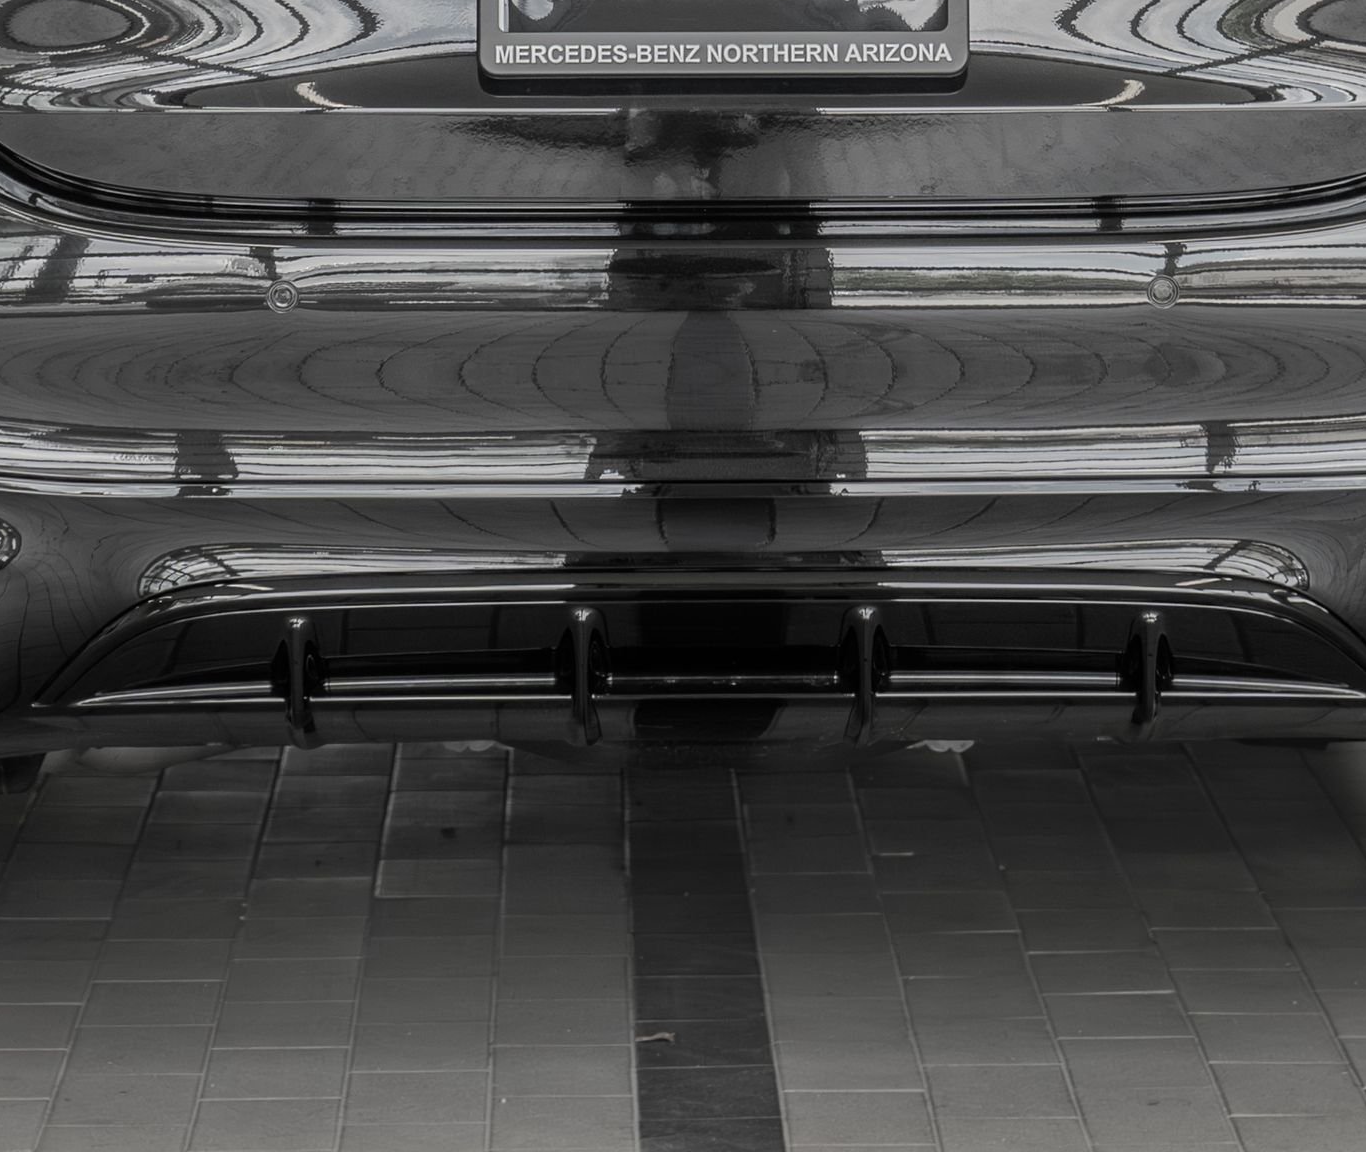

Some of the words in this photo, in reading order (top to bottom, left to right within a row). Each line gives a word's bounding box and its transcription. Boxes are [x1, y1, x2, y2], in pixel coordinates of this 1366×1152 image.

[495, 44, 700, 64] MERCEDES-BENZ
[706, 44, 839, 64] NORTHERN
[844, 43, 953, 63] ARIZONA
